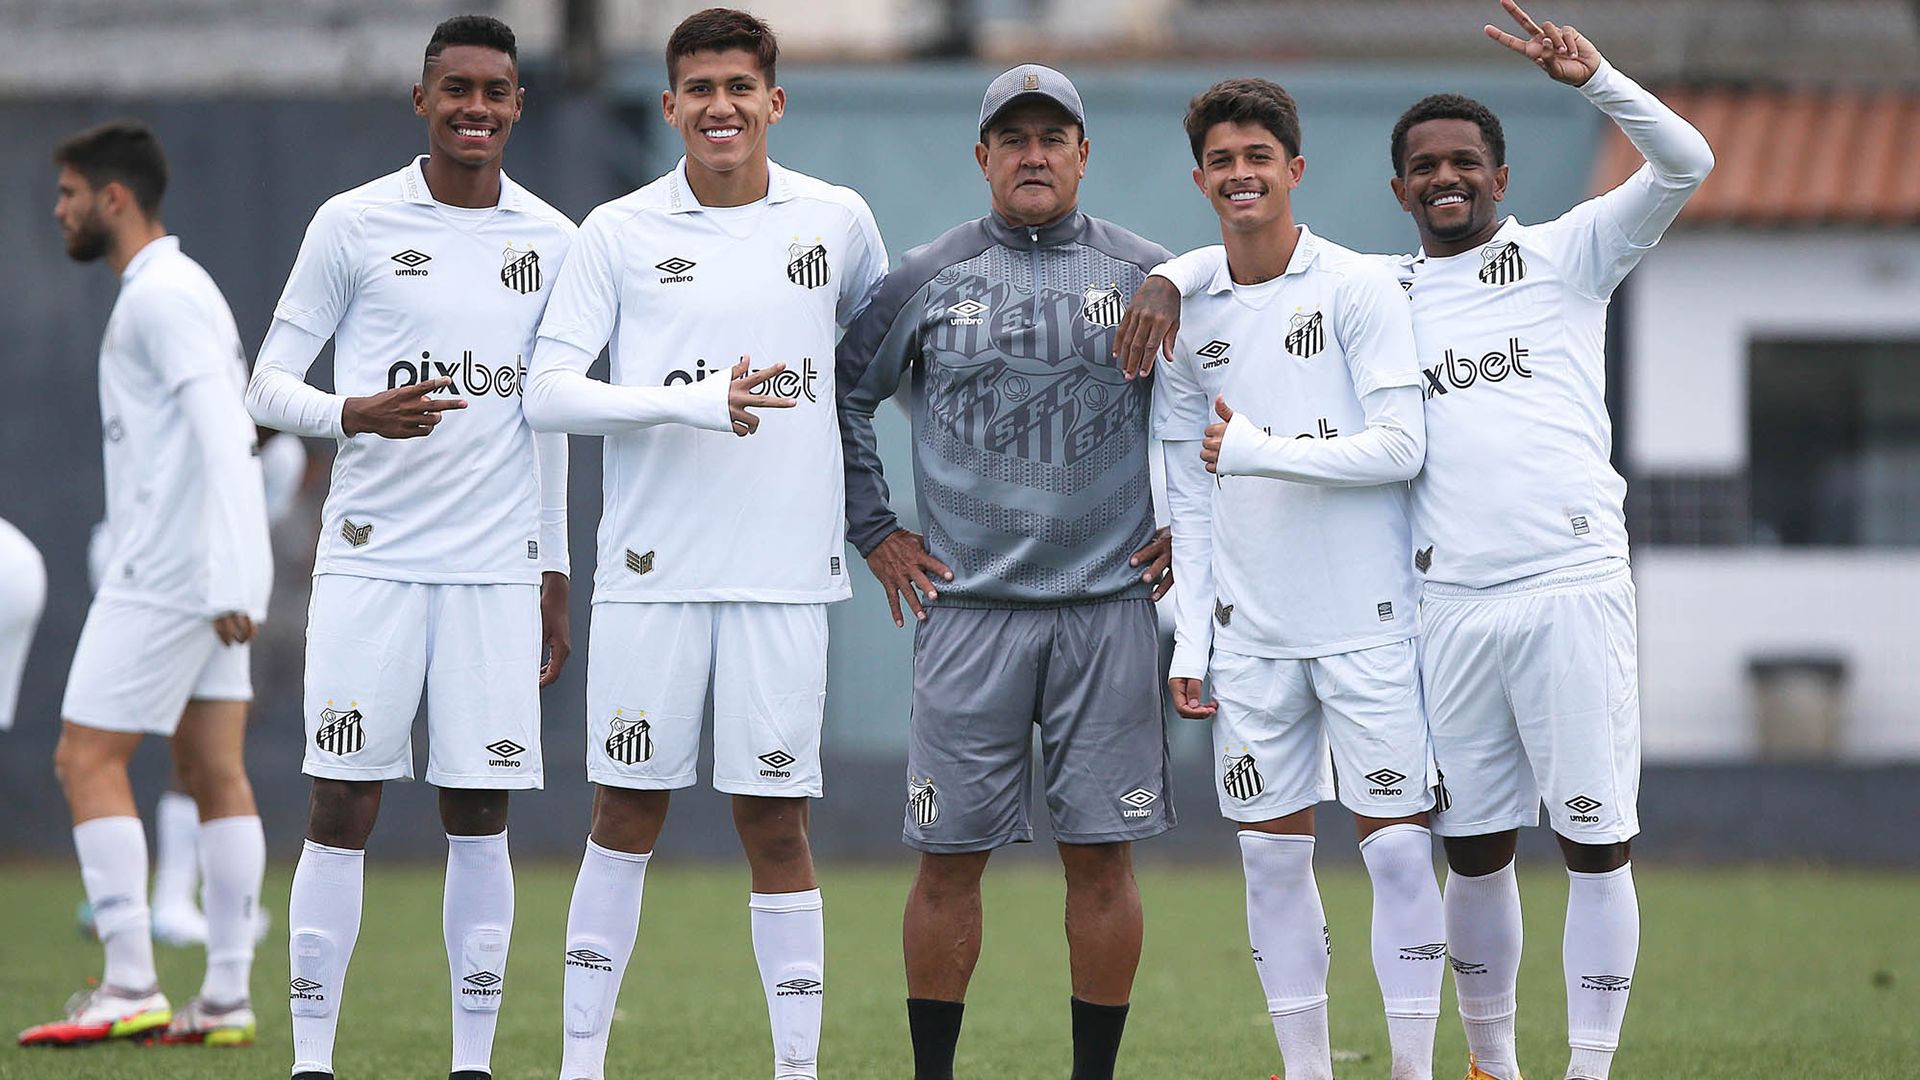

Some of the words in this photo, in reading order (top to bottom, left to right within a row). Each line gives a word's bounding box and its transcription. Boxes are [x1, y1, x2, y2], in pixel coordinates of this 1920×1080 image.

[395, 268, 429, 277] umbro
[660, 275, 693, 284] umbro
[950, 316, 984, 326] umbro
[1202, 357, 1230, 370] umbro
[1422, 337, 1532, 401] xbet
[488, 758, 521, 768] umbro
[760, 768, 791, 778] umbro
[1369, 787, 1403, 796] umbro
[1570, 814, 1600, 823] umbro
[566, 959, 612, 971] umbro
[290, 991, 324, 1001] mbro
[461, 987, 502, 996] umbro
